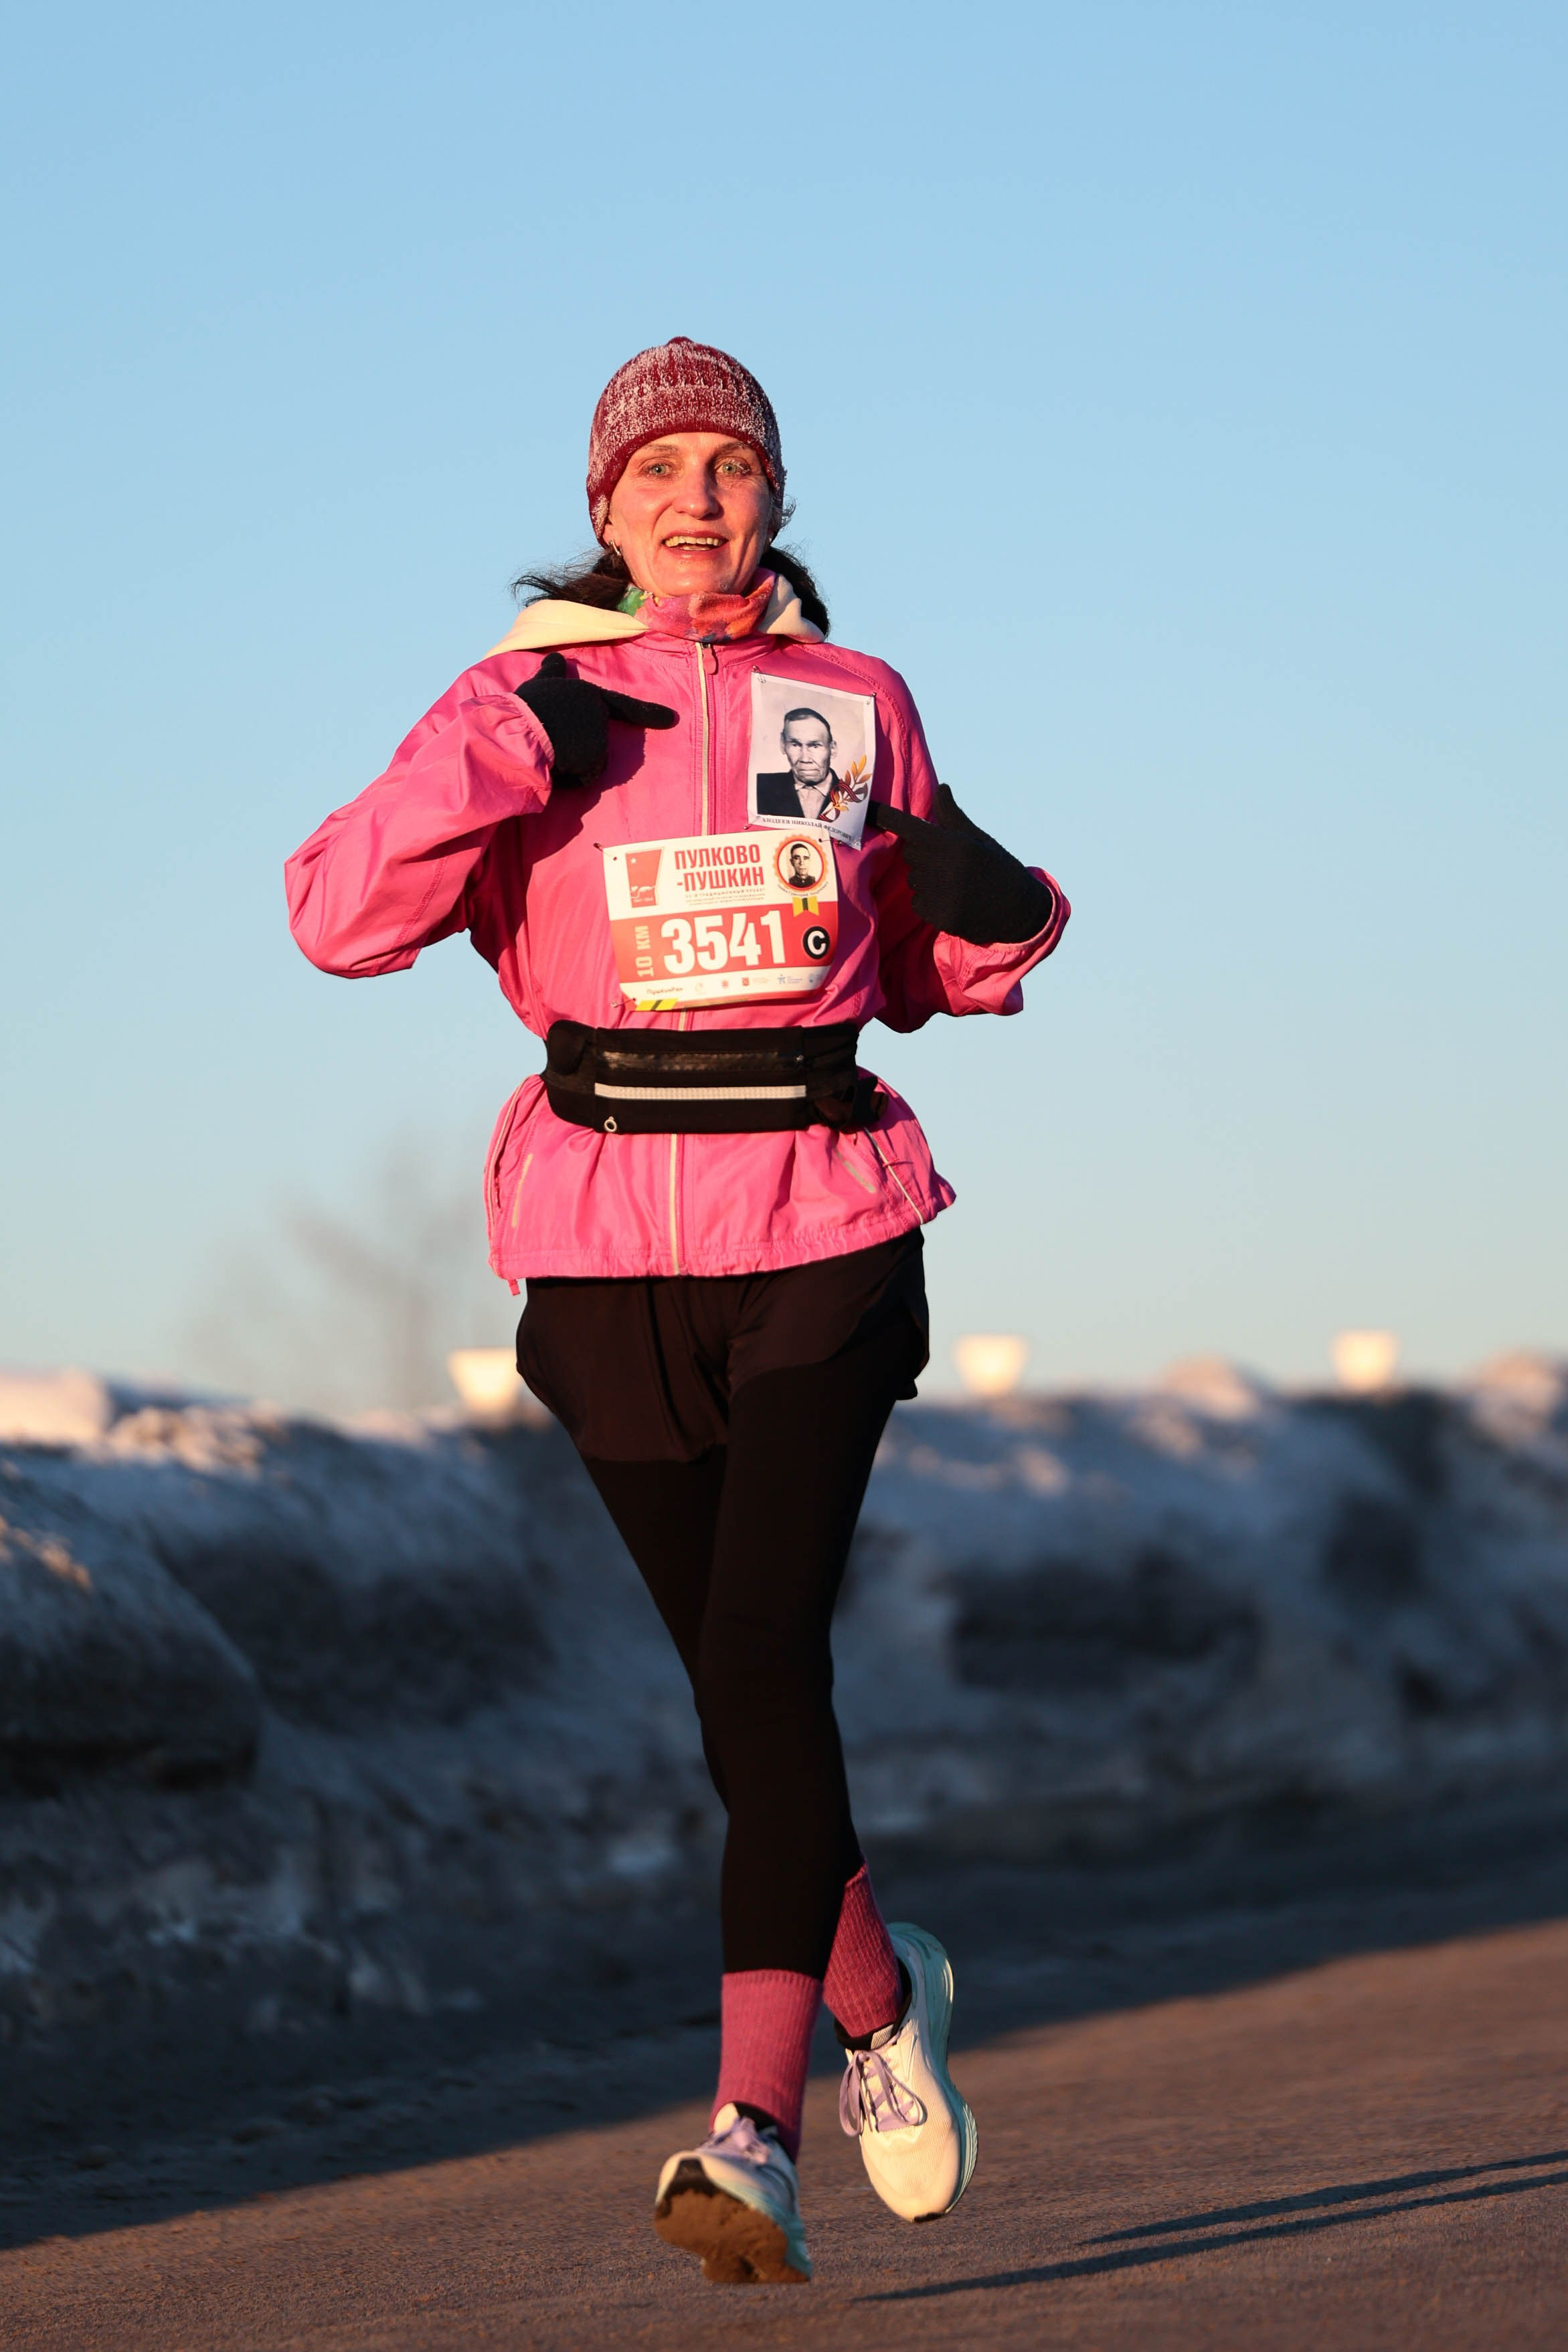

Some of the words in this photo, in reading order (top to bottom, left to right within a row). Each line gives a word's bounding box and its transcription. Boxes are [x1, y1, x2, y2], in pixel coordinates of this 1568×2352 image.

[792, 820, 822, 828] НИКОЛАЙ
[674, 843, 761, 870] ПУЛКОВО
[677, 866, 764, 892] -ПУШКИН
[661, 910, 786, 975] 3541
[635, 956, 654, 977] 10
